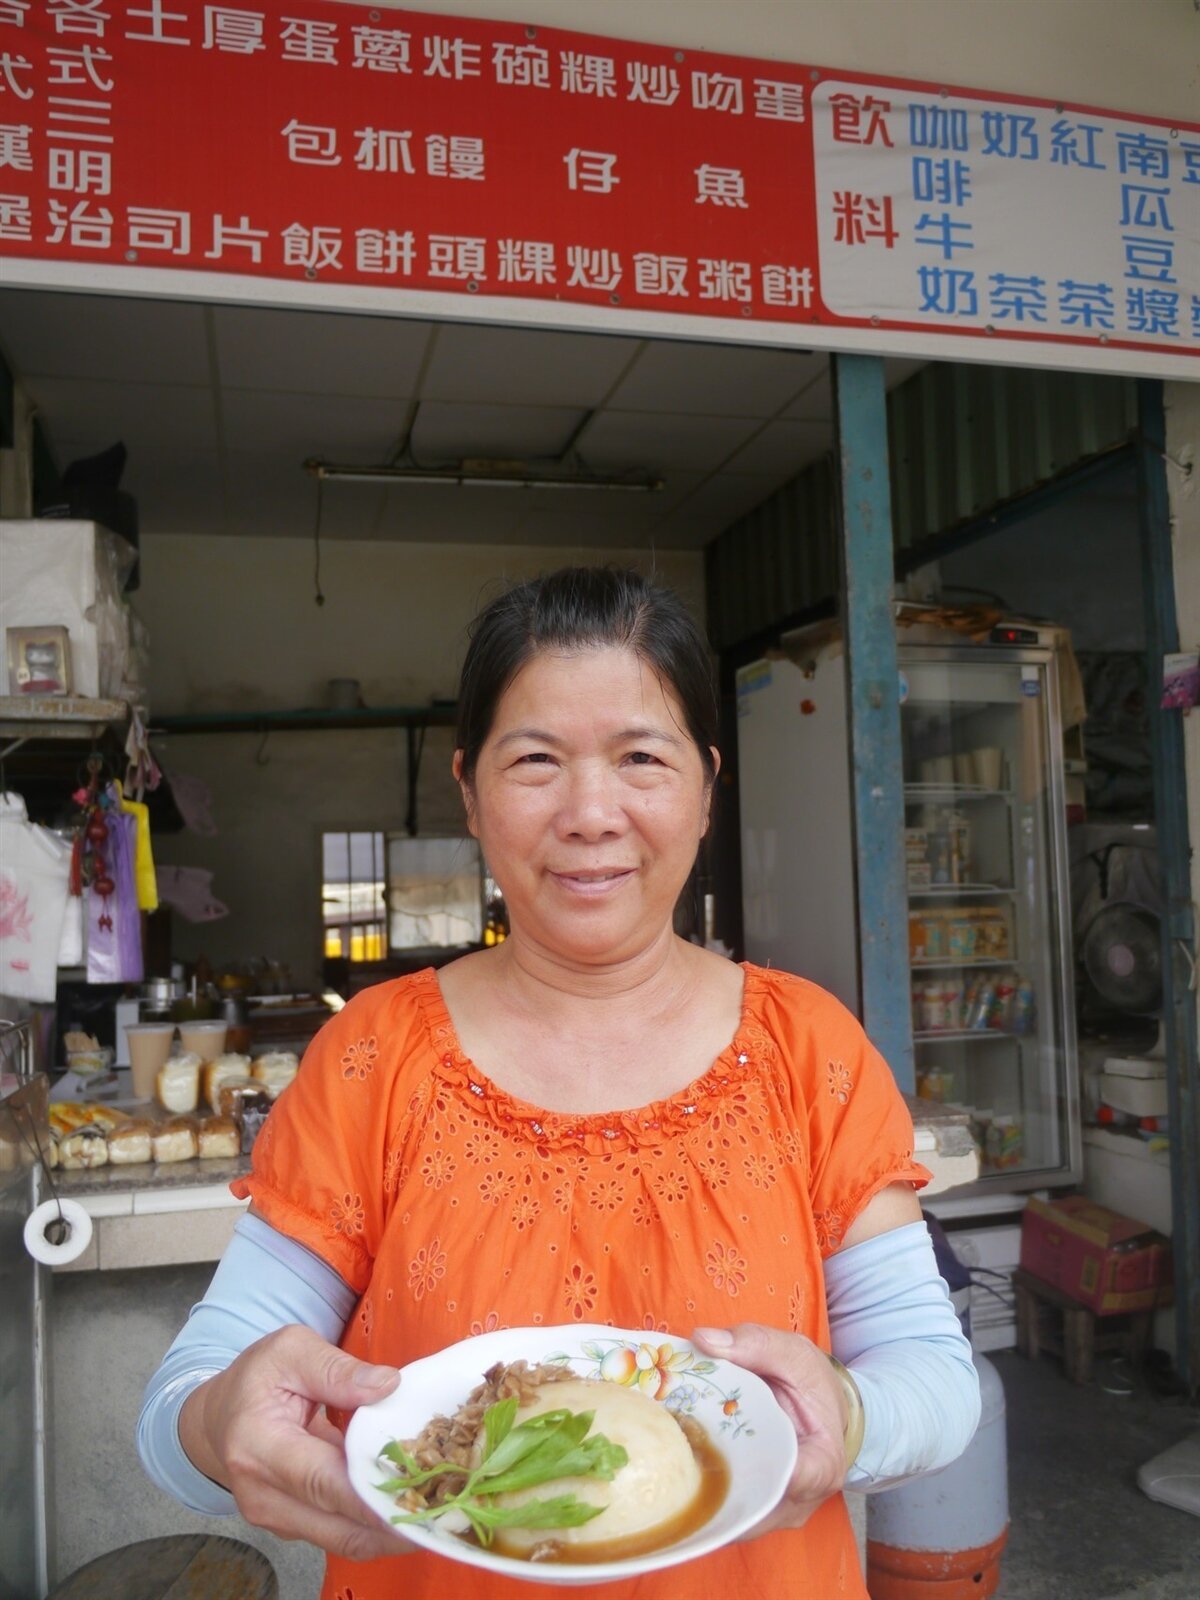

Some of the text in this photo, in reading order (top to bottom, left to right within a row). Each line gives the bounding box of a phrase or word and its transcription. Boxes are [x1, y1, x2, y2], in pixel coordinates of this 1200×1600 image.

[46, 0, 114, 249] 各式三明治
[125, 0, 191, 255] 土司
[202, 5, 269, 263] 厚片
[279, 17, 343, 270] 蛋包飯
[351, 26, 417, 276] 蔥抓餅
[423, 35, 488, 281] 炸饅頭
[492, 42, 557, 285] 碗粿
[560, 51, 623, 291] 粿仔炒
[626, 60, 690, 298] 炒飯
[691, 71, 752, 302] 吻魚粥
[753, 78, 814, 309] 蛋餅
[829, 93, 899, 249] 飲料
[909, 103, 978, 316] 咖啡牛奶
[981, 112, 1047, 324] 奶茶
[1049, 119, 1115, 329] 紅茶
[1115, 132, 1180, 337] 南瓜豆漿
